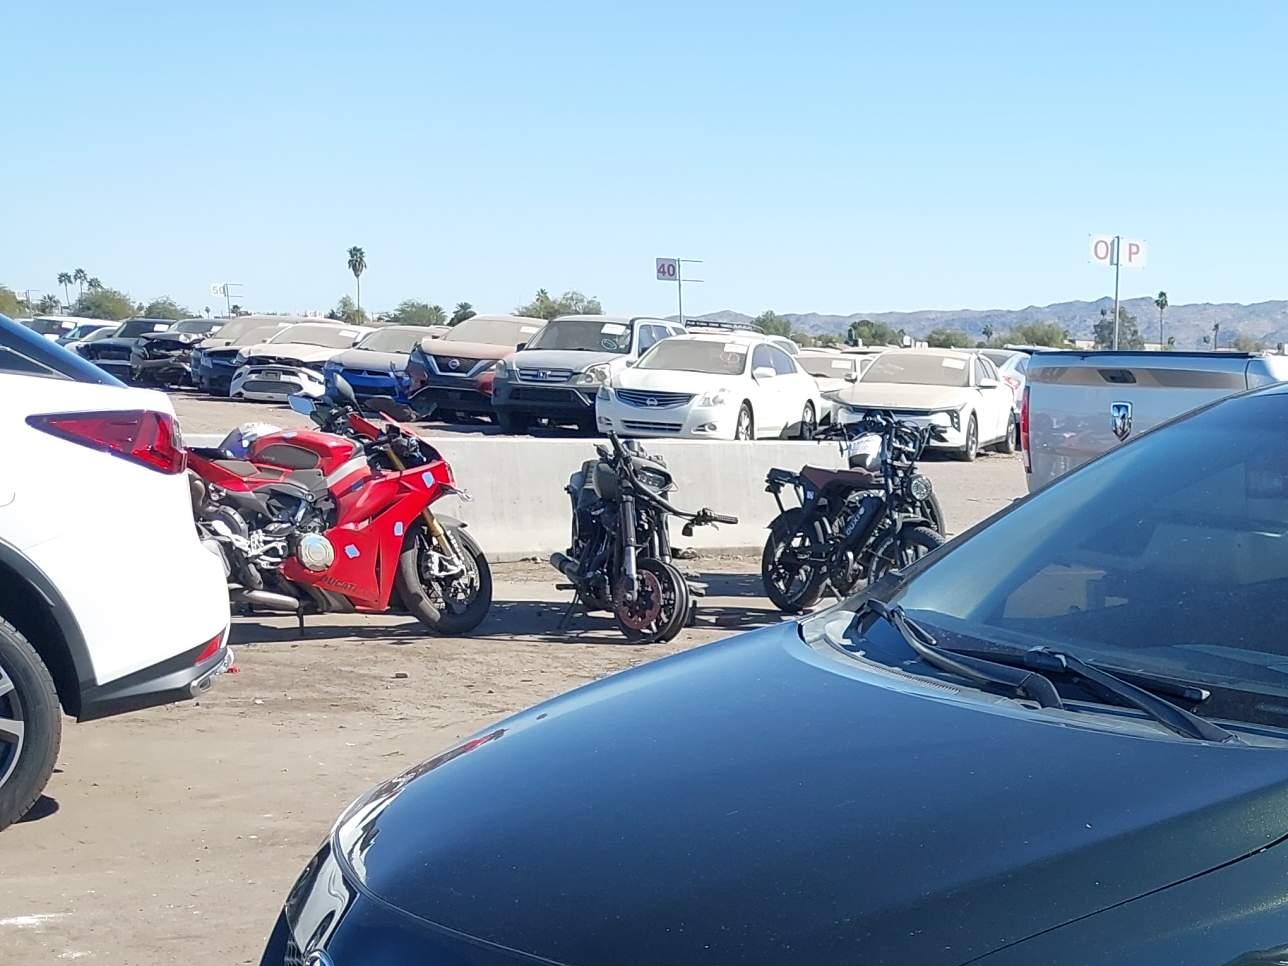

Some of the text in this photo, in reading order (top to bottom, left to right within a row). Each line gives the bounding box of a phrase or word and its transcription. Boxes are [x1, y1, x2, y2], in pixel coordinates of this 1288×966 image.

[1094, 240, 1109, 260] O
[1128, 242, 1140, 263] P
[657, 263, 676, 277] 40
